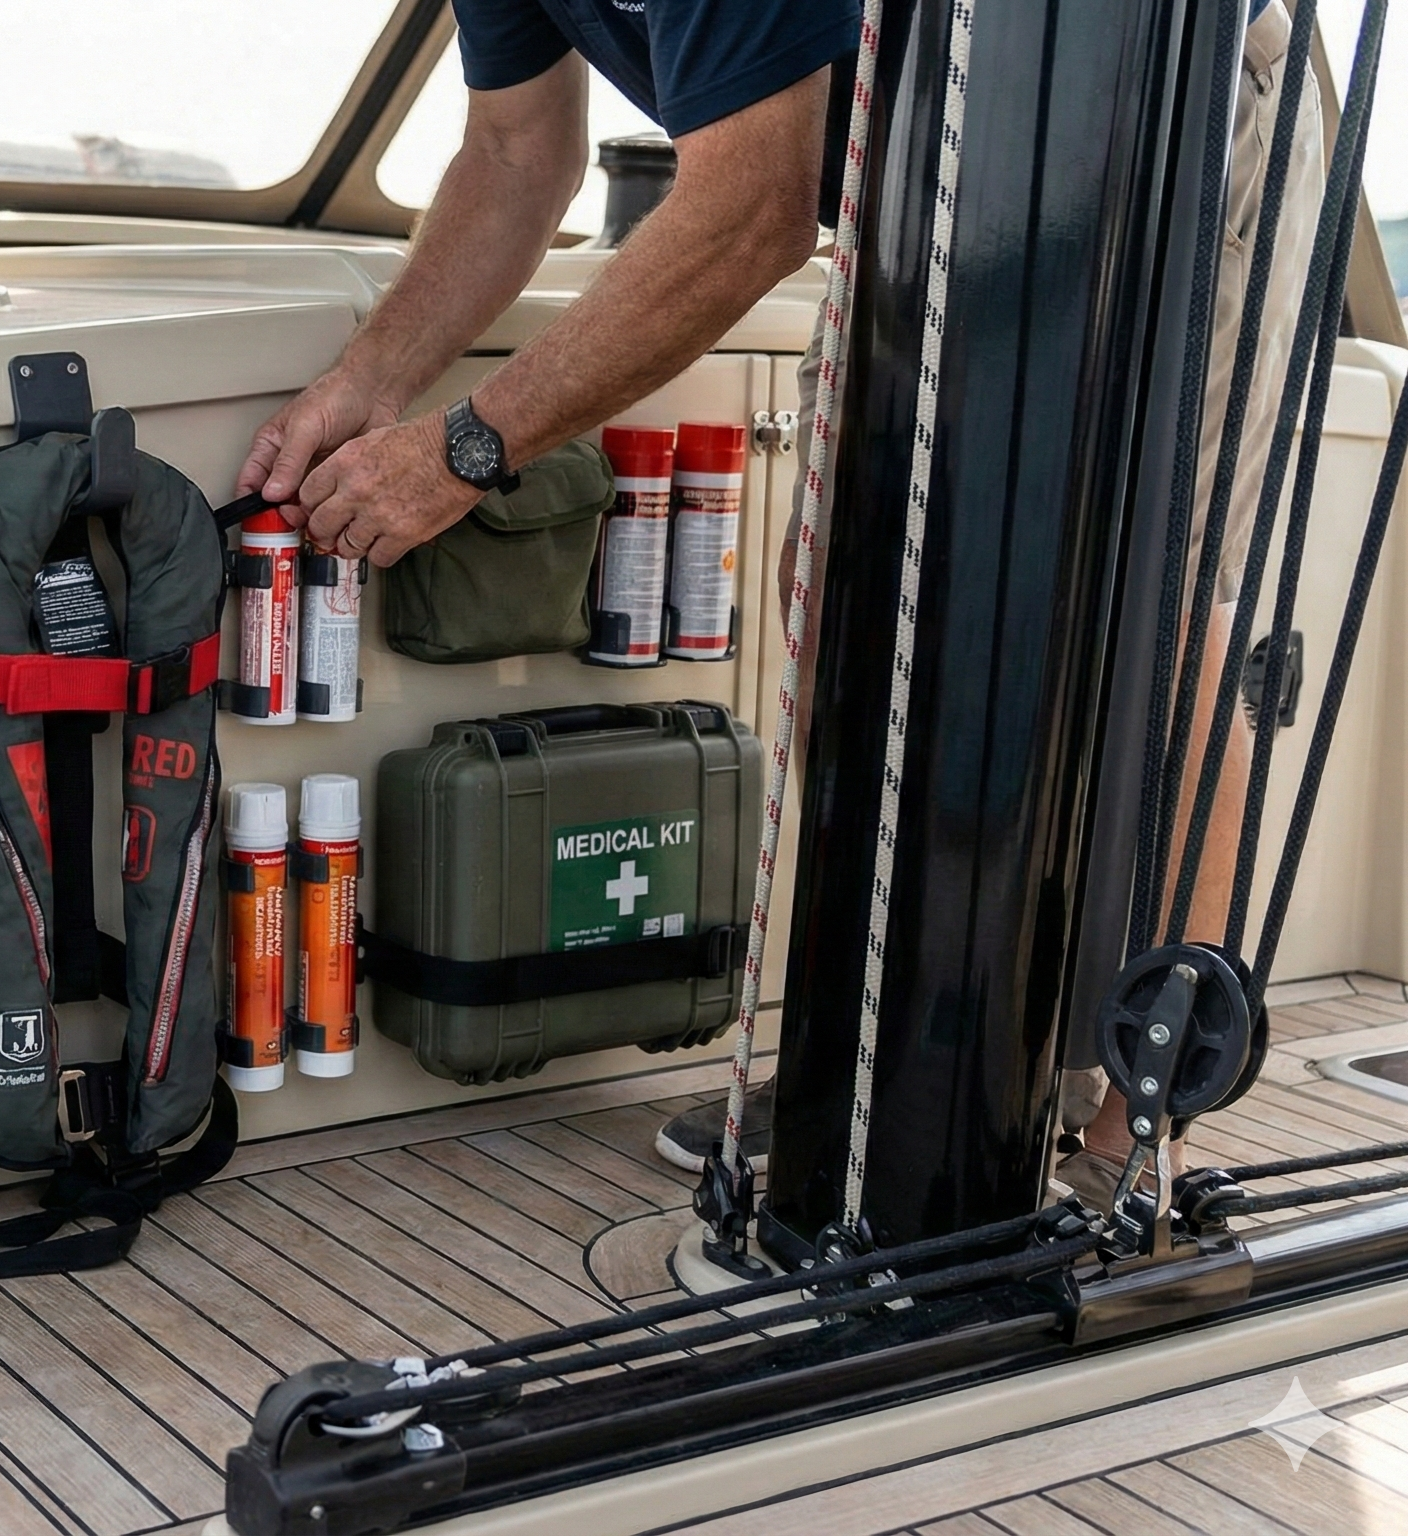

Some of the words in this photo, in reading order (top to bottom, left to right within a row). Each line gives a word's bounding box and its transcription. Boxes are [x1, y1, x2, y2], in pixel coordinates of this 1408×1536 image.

[132, 734, 197, 780] RED
[557, 826, 655, 861] MEDICAL
[660, 820, 695, 847] KIT
